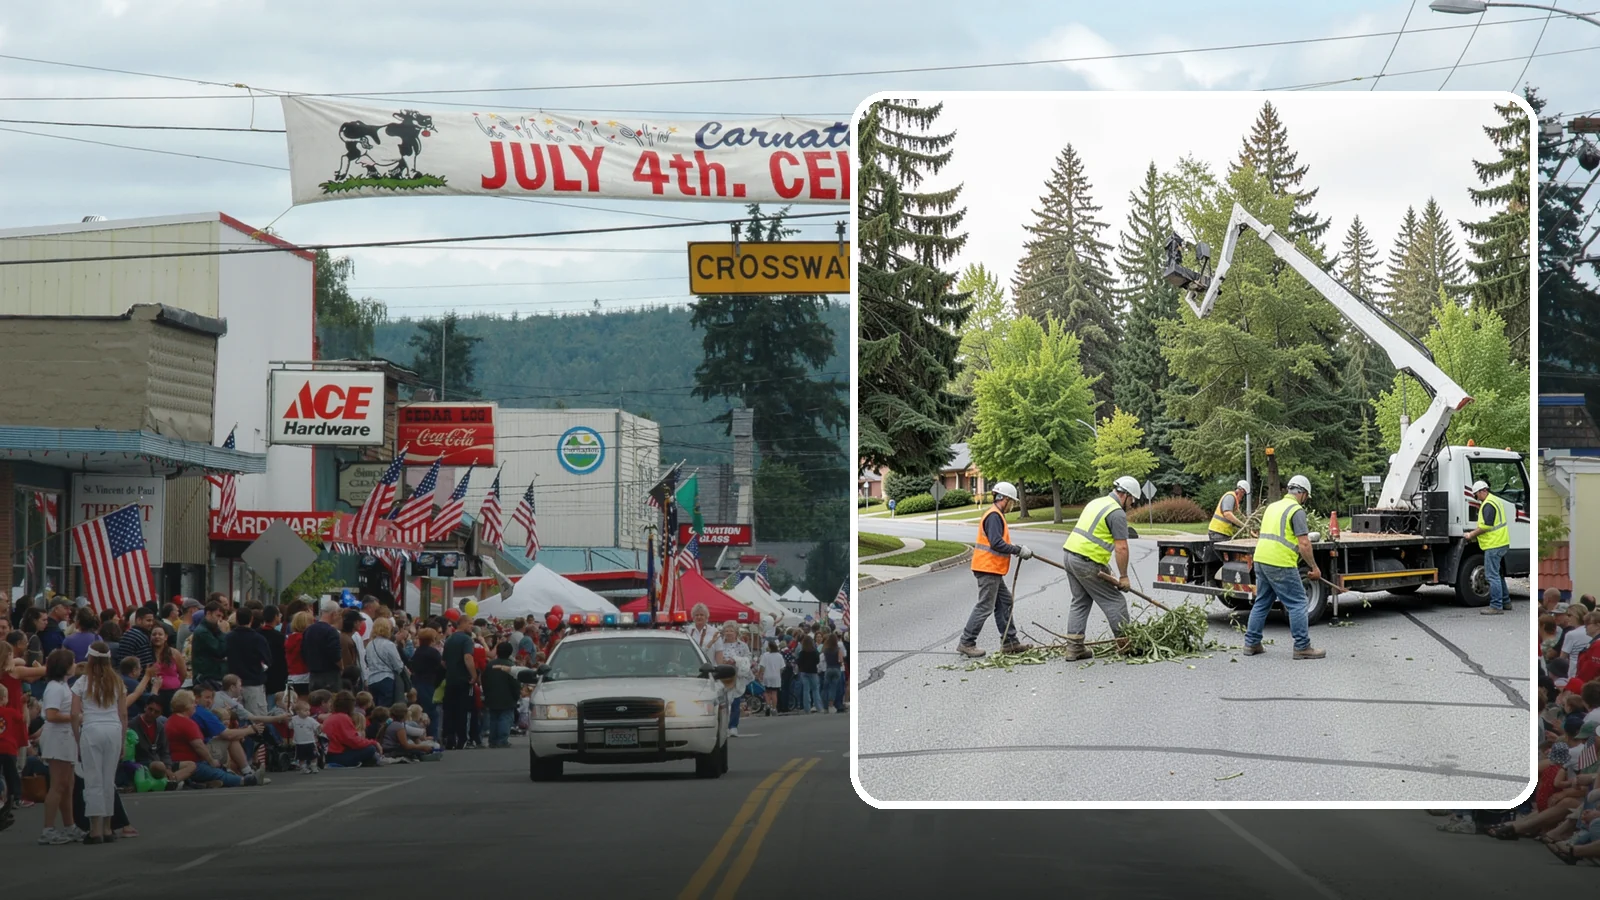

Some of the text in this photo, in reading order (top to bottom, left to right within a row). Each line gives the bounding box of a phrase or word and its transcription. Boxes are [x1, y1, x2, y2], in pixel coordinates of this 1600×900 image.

[481, 141, 605, 193] JULY
[632, 150, 746, 198] 4th.
[697, 254, 850, 280] CROSSWA
[283, 380, 374, 420] ACE
[405, 409, 485, 422] CEDAR LOG
[283, 421, 371, 437] Hardware
[95, 485, 124, 495] Vincent
[126, 486, 136, 495] de
[138, 486, 155, 496] Paul
[212, 516, 330, 536] HARDARE
[688, 526, 741, 535] CRNATION
[699, 535, 730, 543] GLASS
